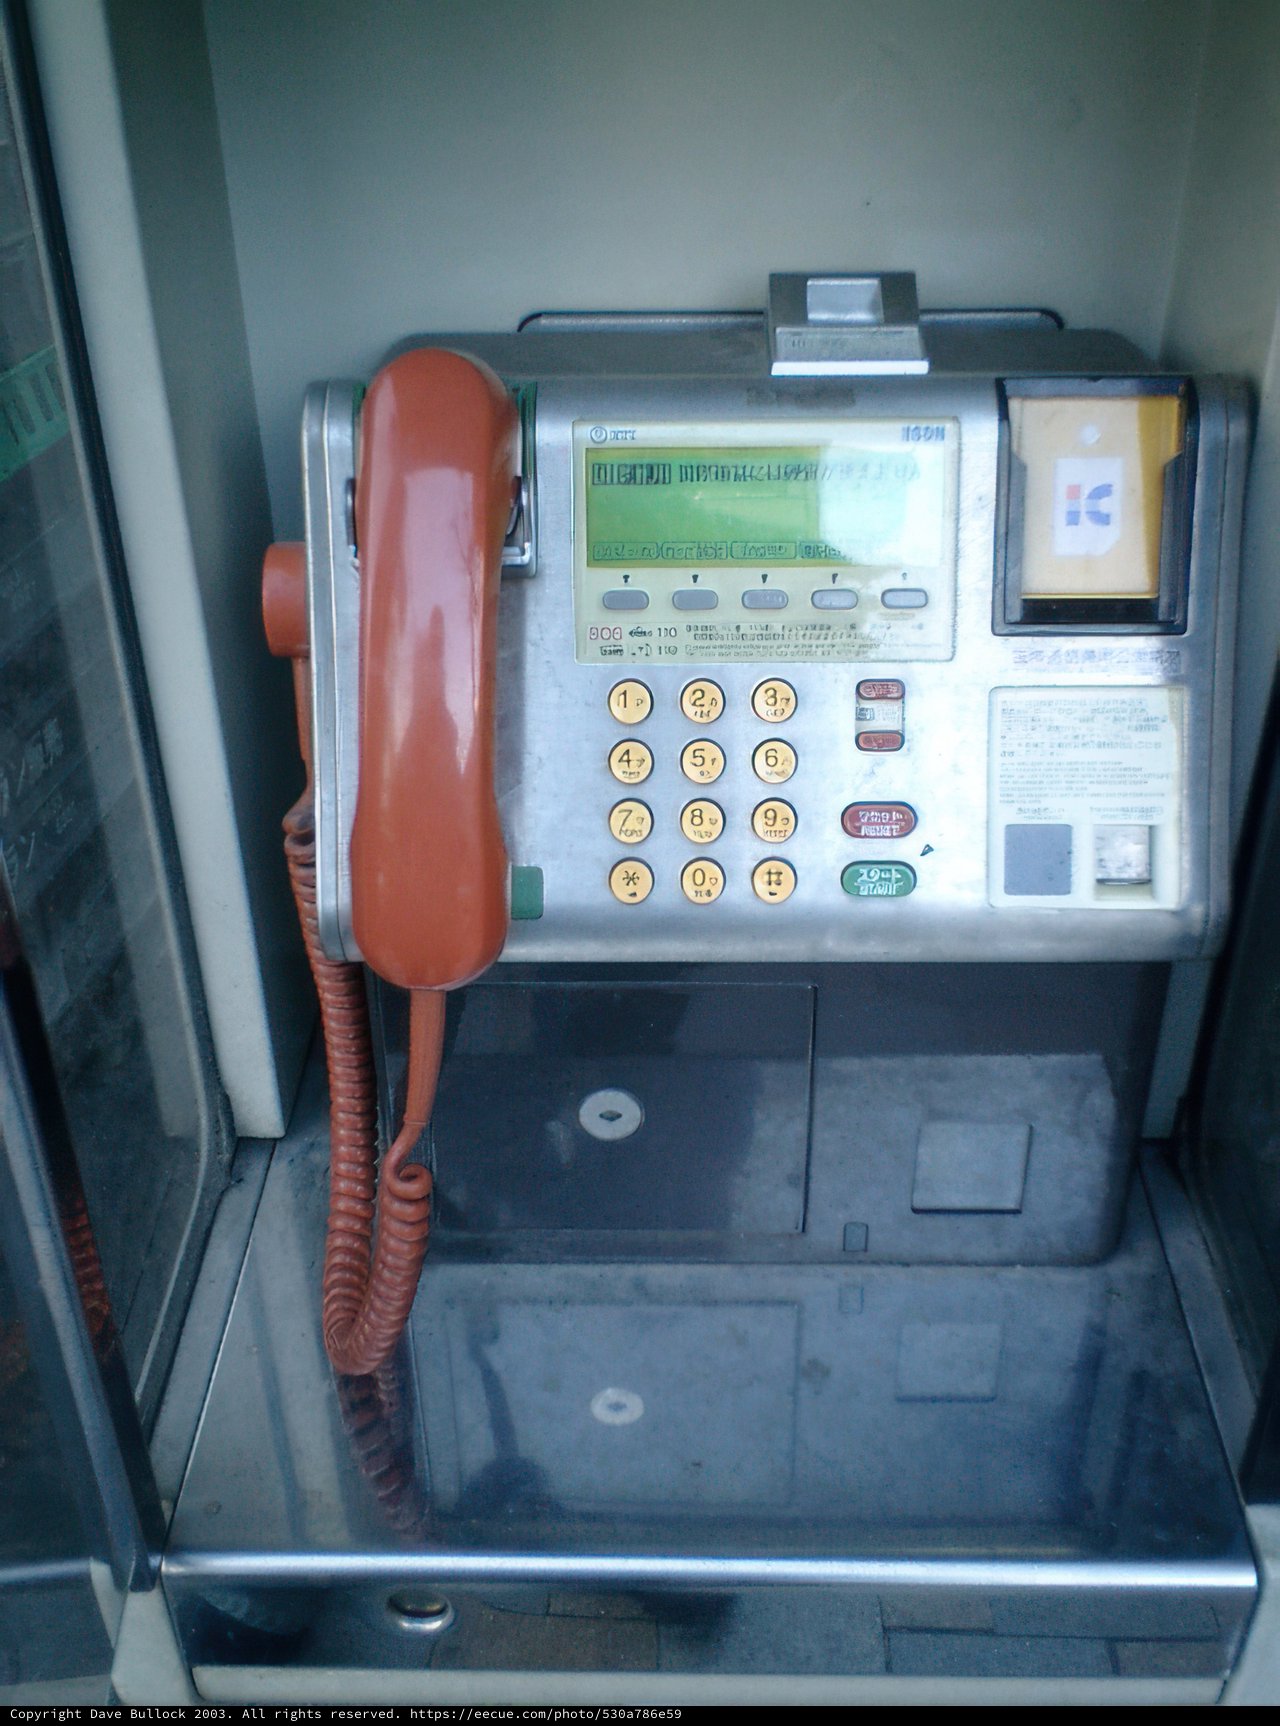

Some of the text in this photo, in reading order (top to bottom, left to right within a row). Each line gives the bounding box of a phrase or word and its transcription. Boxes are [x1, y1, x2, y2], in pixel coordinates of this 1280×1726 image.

[617, 688, 628, 709] 1
[691, 688, 705, 707] 2
[764, 687, 777, 707] 3
[618, 748, 632, 769] 4
[690, 748, 705, 768] 5
[764, 748, 778, 768] 6
[618, 809, 633, 834] 7
[690, 808, 704, 827] 8
[764, 808, 777, 827] 9
[692, 868, 706, 887] 0
